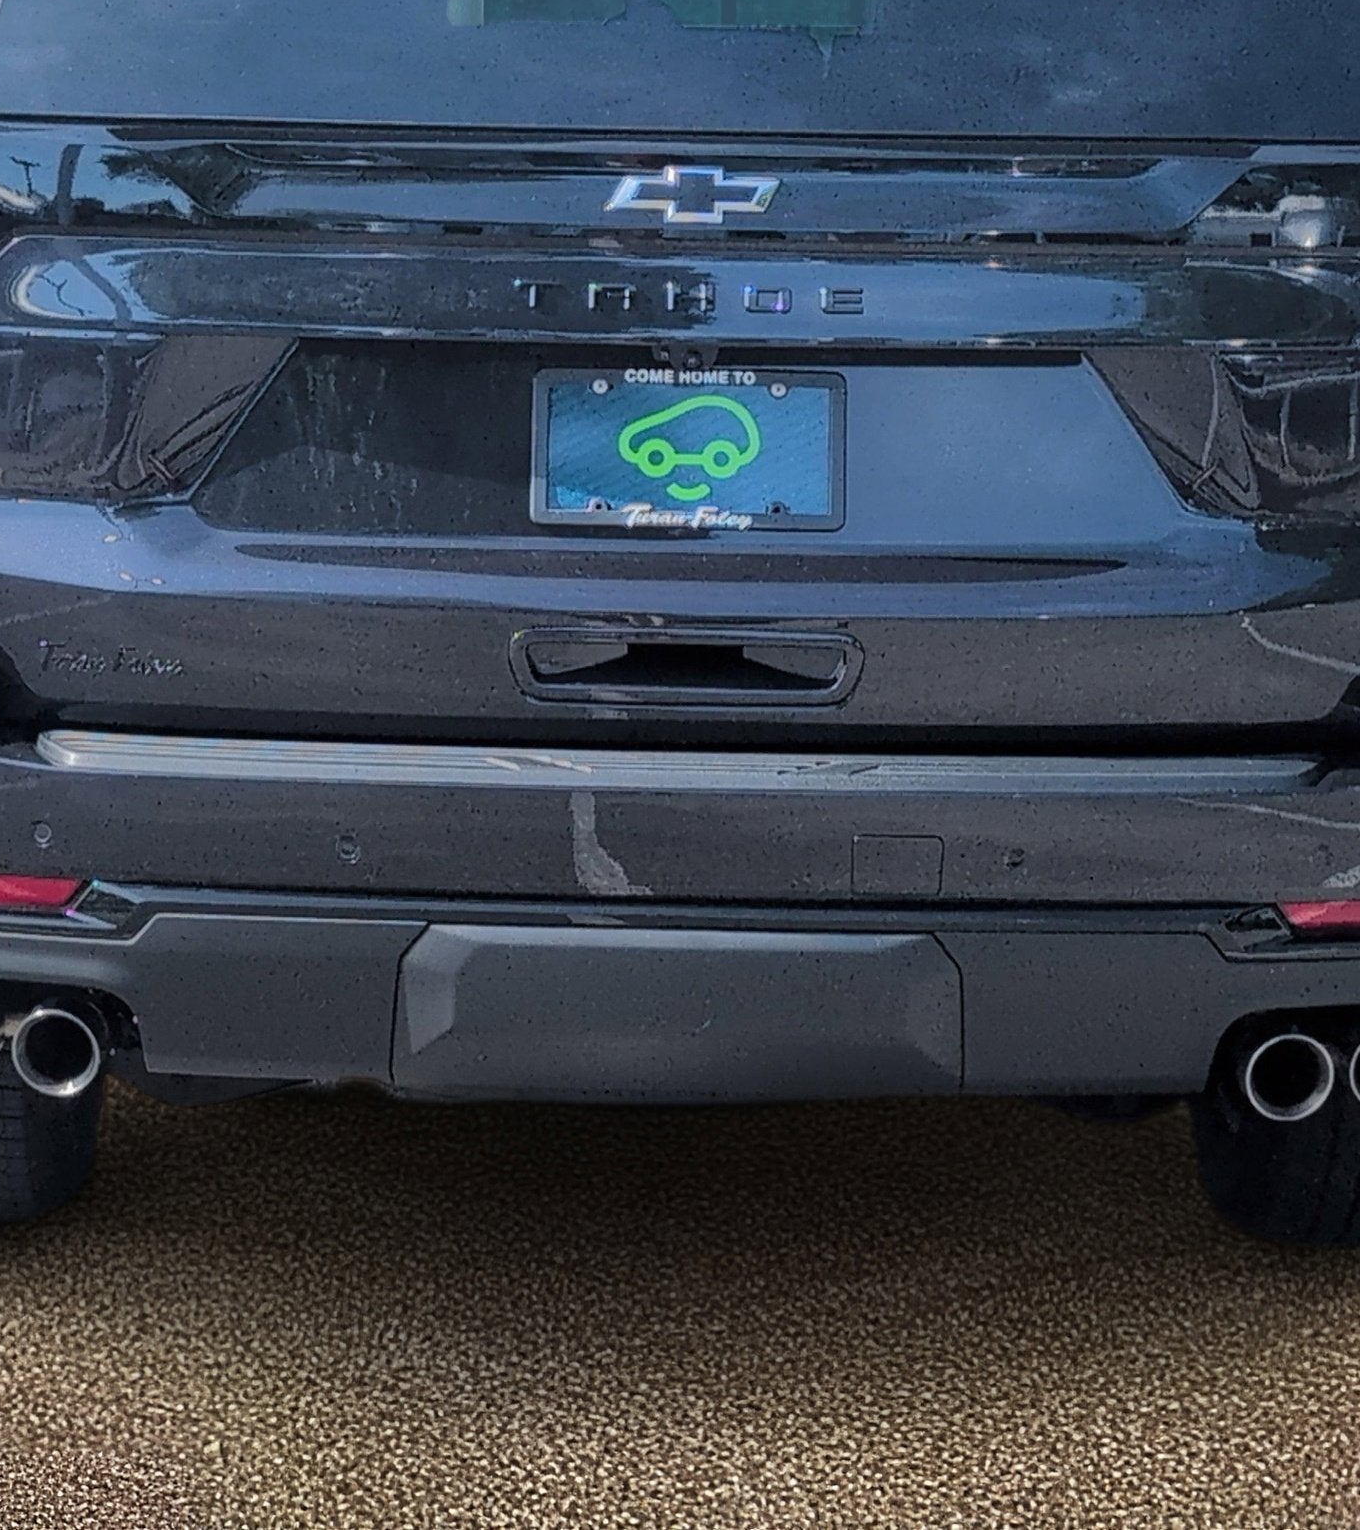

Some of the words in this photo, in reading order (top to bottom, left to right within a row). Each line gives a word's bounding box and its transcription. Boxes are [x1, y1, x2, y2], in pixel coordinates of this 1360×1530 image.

[624, 368, 674, 384] COME
[678, 370, 729, 385] HOME
[733, 371, 757, 385] TO
[621, 502, 686, 529] Turan
[690, 506, 753, 531] Foley
